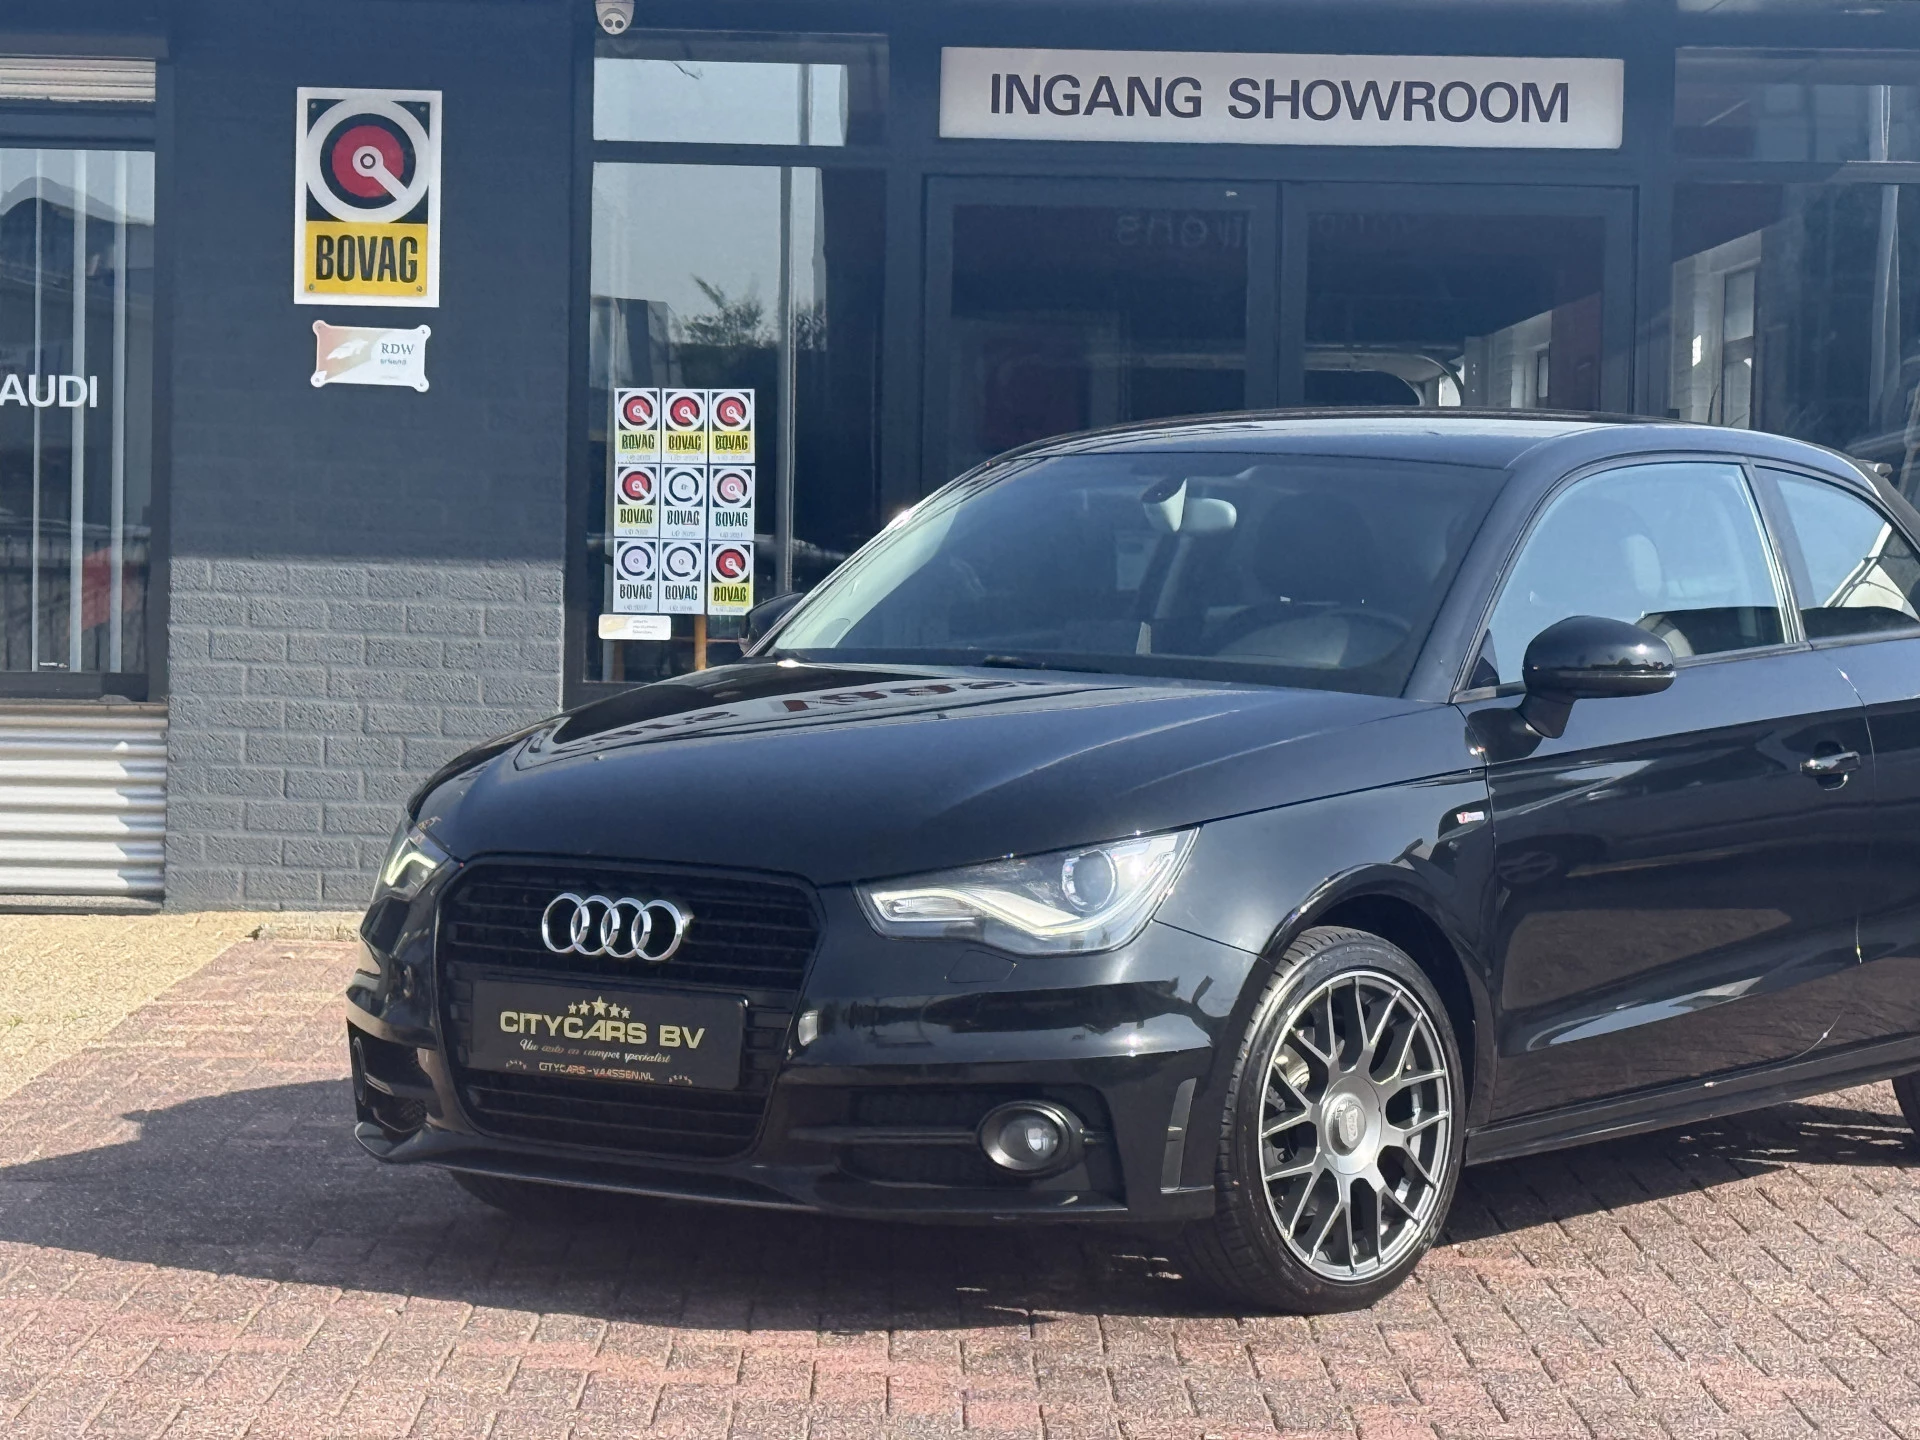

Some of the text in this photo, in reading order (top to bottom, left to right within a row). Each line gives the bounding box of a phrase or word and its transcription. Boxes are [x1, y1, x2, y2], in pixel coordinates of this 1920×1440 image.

[990, 73, 1570, 123] INGANG SHOWROOM
[316, 234, 418, 283] BOVAG
[381, 343, 415, 355] RDW
[0, 373, 98, 408] AUDI
[621, 434, 655, 450] BOVAG
[668, 435, 702, 451] BOVAG
[715, 435, 749, 451] BOVAG
[620, 508, 653, 524] BOVAG
[667, 509, 700, 526] BOVAG
[715, 511, 748, 527] BOVAG
[619, 583, 653, 600] BOVAG
[665, 585, 698, 601] BOVAG
[713, 586, 747, 603] BOVAG
[499, 1011, 706, 1049] CITYCARS BV
[538, 1061, 655, 1081] CITYCARS-VAASSEN.NL
